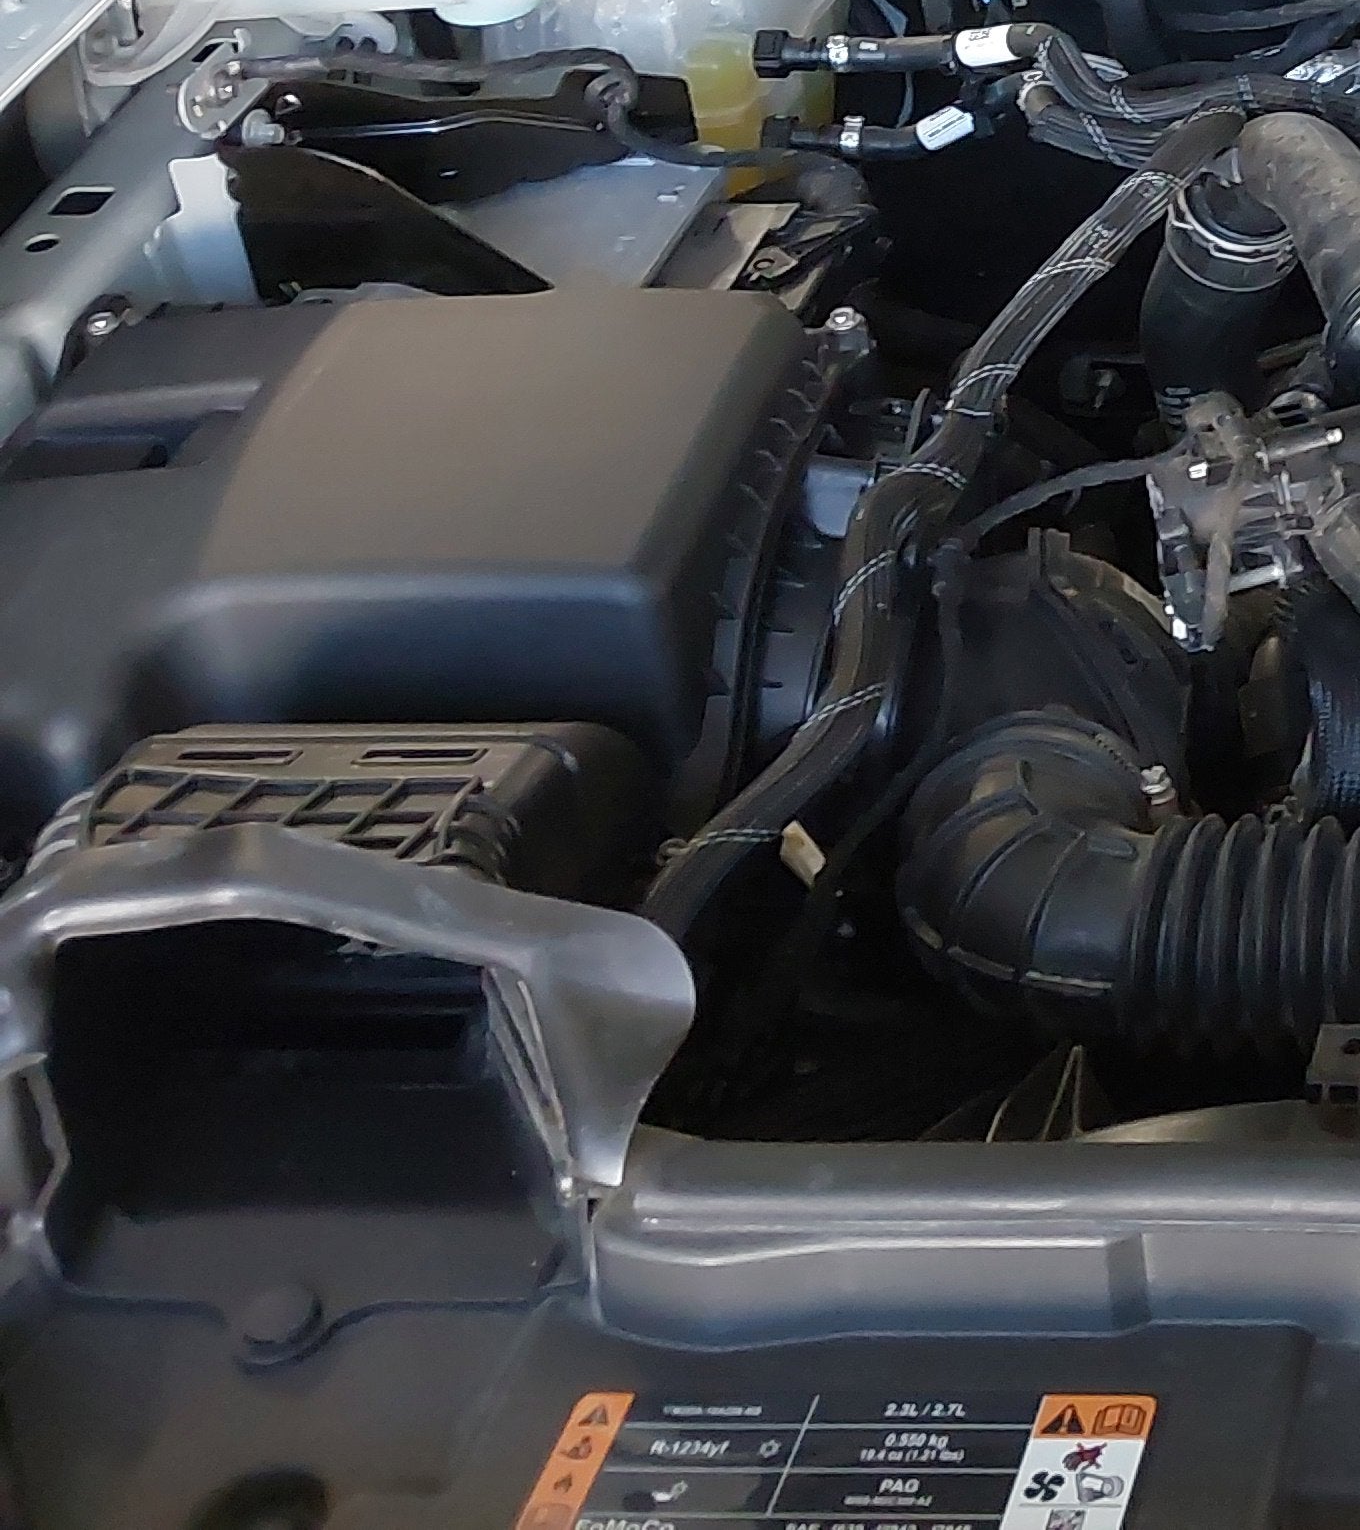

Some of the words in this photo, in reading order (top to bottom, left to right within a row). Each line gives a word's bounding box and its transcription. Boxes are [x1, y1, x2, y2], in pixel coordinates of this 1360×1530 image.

[931, 1402, 966, 1417] 2.7L
[650, 1439, 731, 1458] R-1234yf
[928, 1433, 950, 1449] kg
[878, 1477, 921, 1494] PAG
